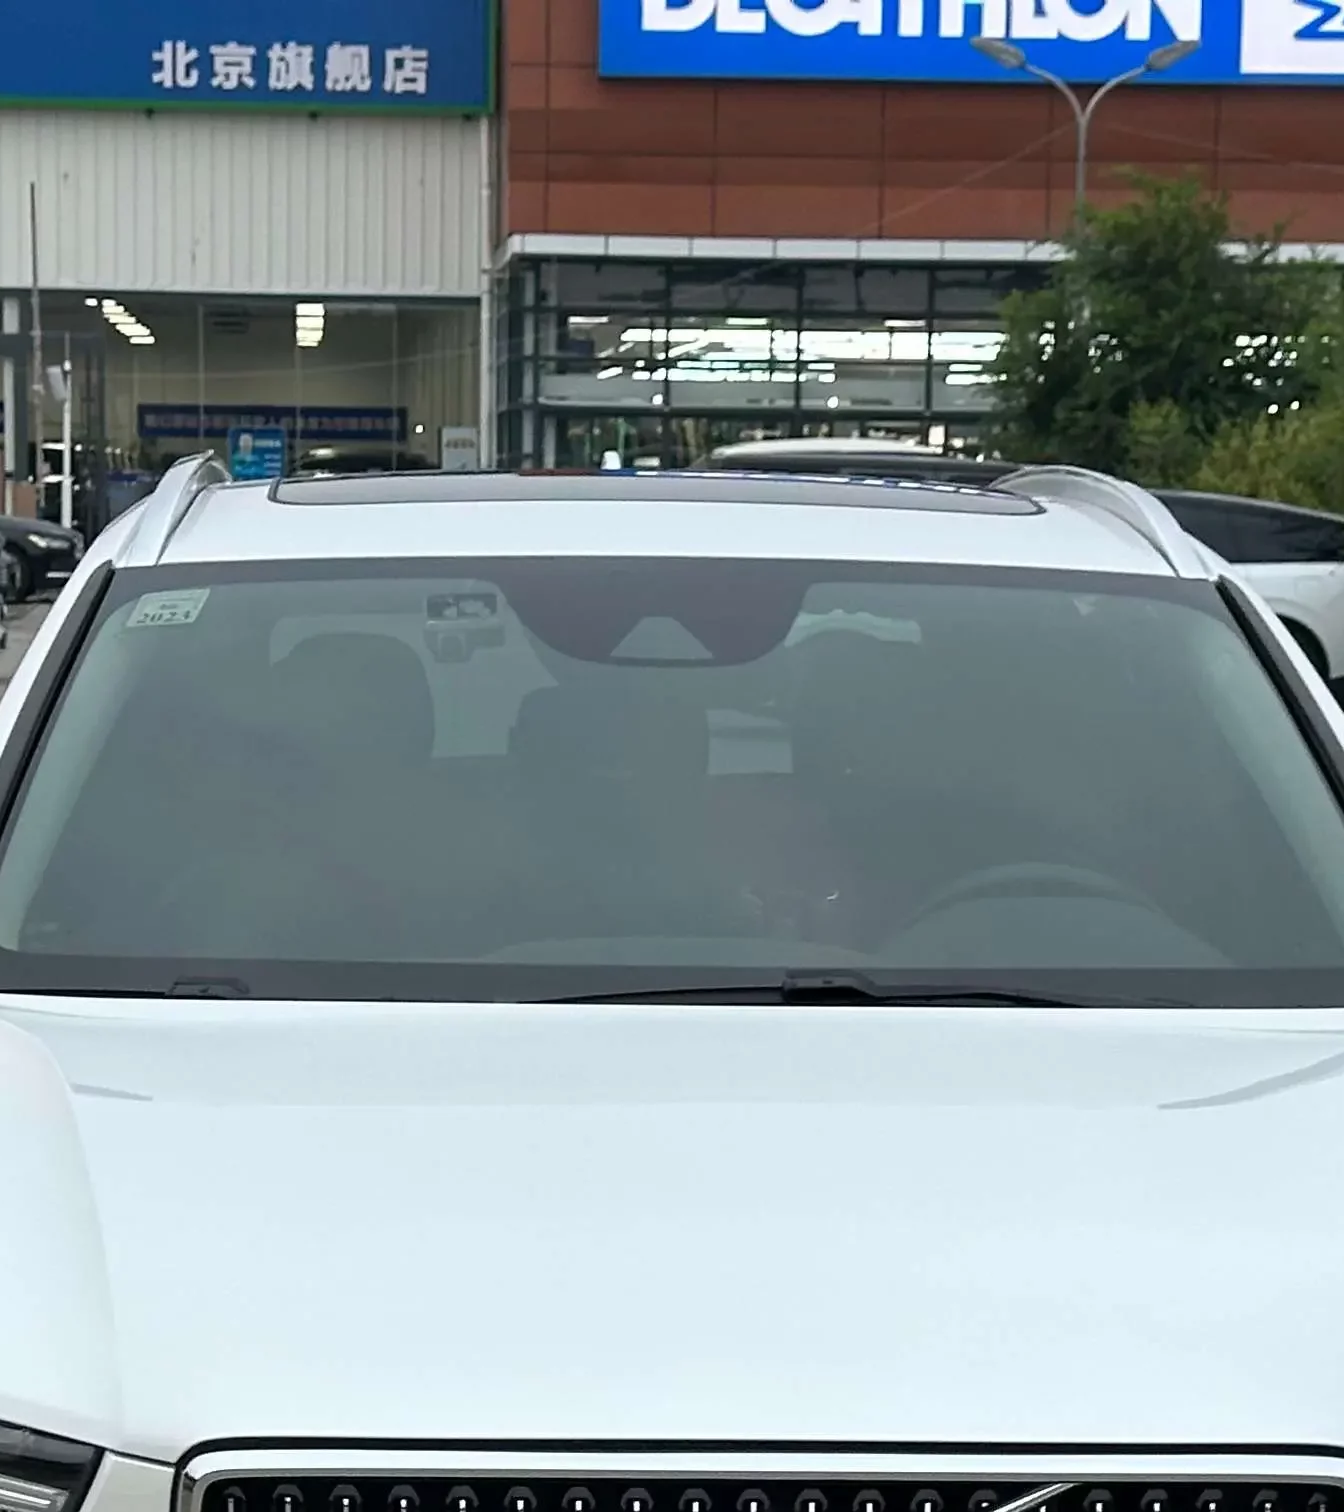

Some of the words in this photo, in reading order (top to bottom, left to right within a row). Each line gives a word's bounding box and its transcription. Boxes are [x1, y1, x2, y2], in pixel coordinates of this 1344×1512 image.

[152, 40, 429, 94] 北京旗舰店
